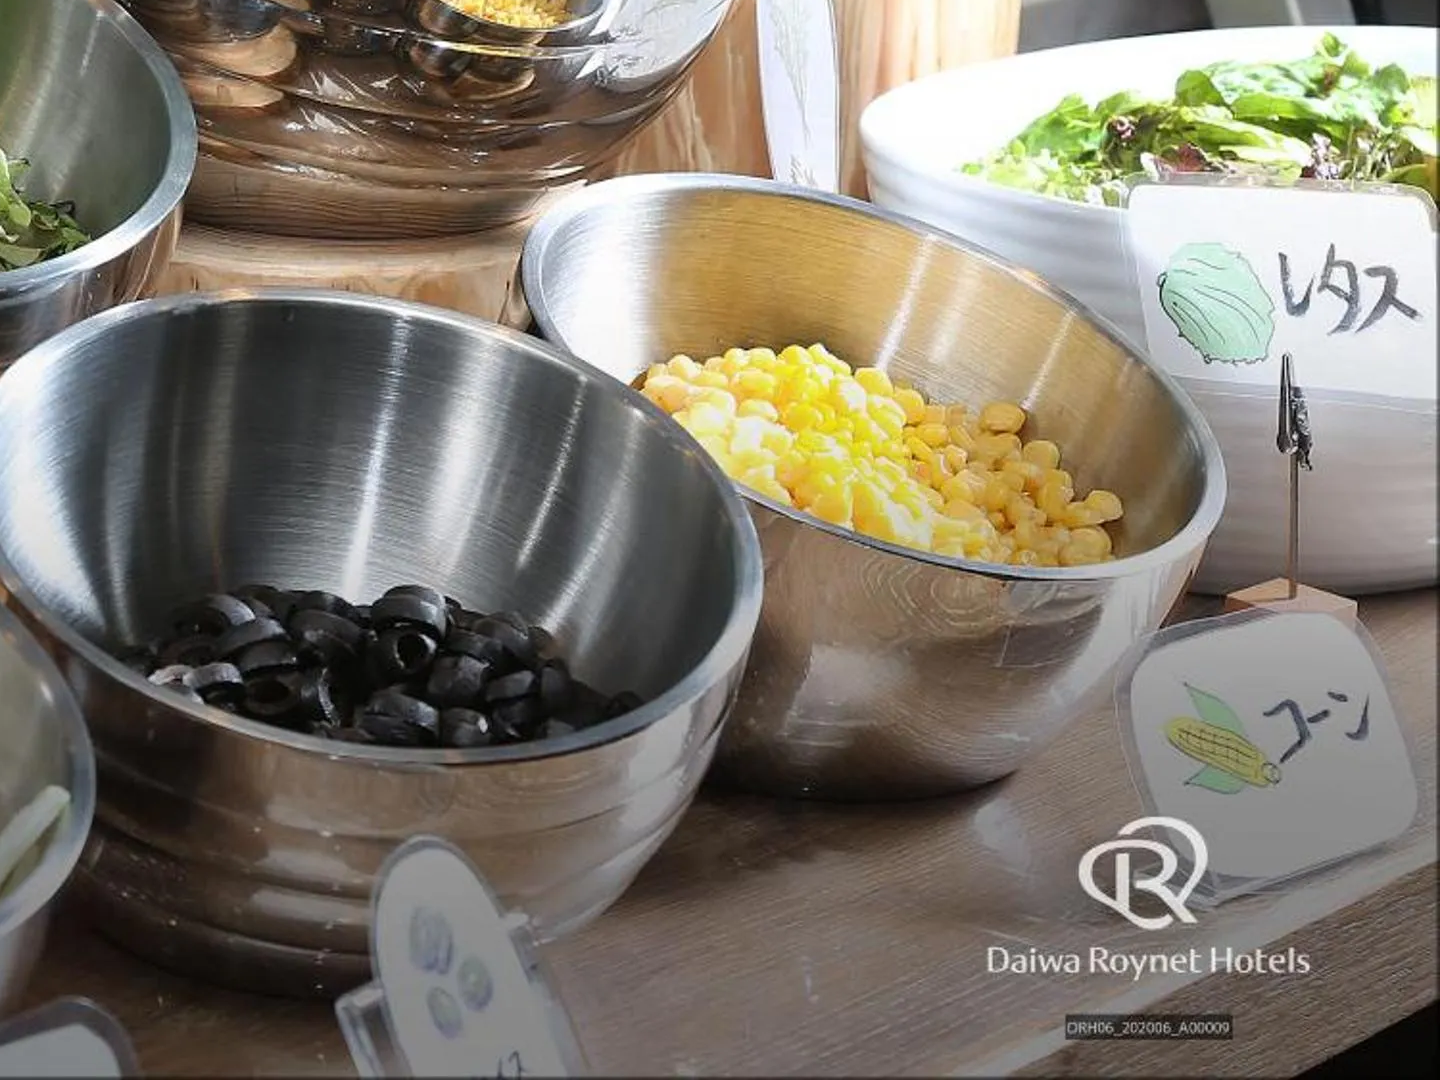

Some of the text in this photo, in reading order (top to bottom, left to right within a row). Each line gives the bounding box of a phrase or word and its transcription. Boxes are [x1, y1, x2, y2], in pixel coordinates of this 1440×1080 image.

[1277, 242, 1422, 337] レタス
[1263, 690, 1371, 764] コーン
